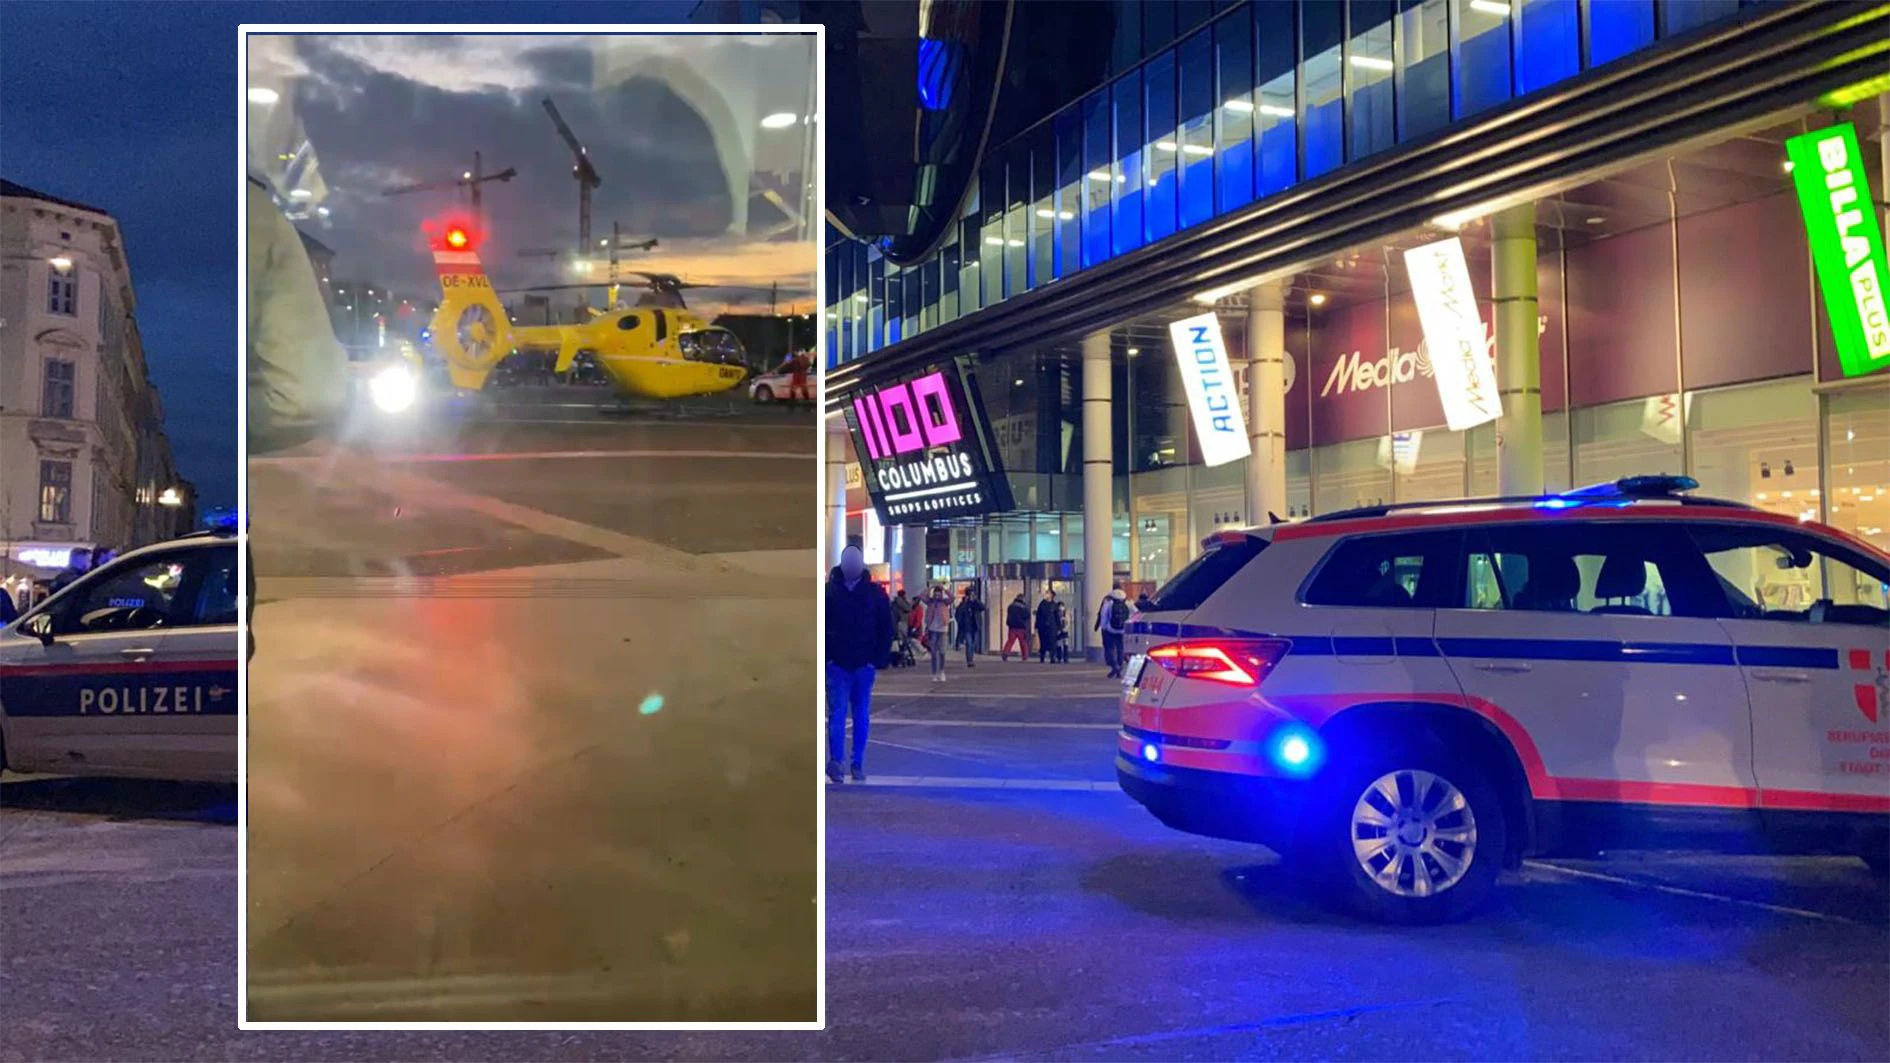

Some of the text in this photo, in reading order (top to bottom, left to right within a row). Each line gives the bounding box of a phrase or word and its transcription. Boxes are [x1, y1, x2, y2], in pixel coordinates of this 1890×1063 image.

[1817, 135, 1871, 268] BILLA
[442, 275, 490, 288] OE-XVL
[1858, 276, 1887, 348] PLUS
[1188, 326, 1235, 432] ACTION
[1320, 346, 1418, 397] Media
[853, 371, 962, 460] 1100
[878, 451, 972, 491] COLUMBUS
[888, 501, 922, 516] SHOPS
[931, 493, 982, 510] OFFICES
[80, 686, 201, 713] POLIZEI
